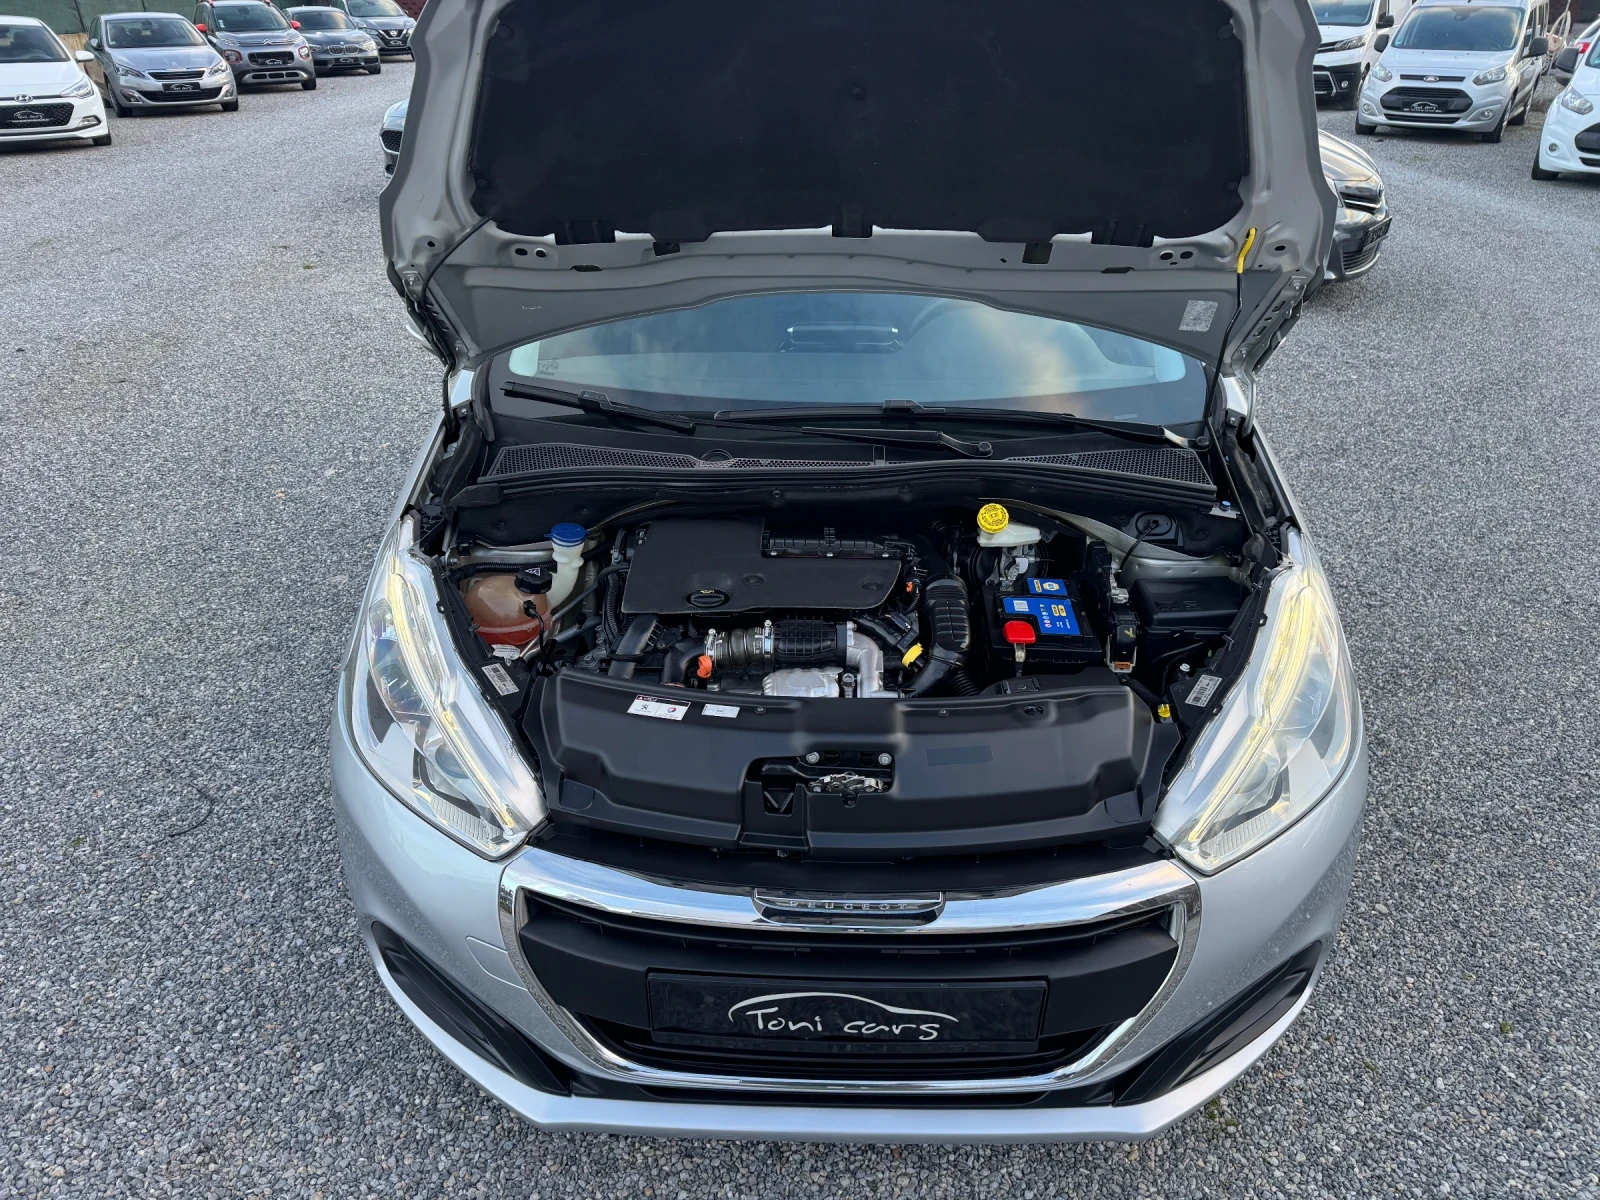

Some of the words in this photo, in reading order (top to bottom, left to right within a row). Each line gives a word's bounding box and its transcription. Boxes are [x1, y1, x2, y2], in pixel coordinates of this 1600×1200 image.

[790, 900, 909, 910] PEUGEOT
[745, 1007, 822, 1032] Toni
[843, 1020, 941, 1040] cars
